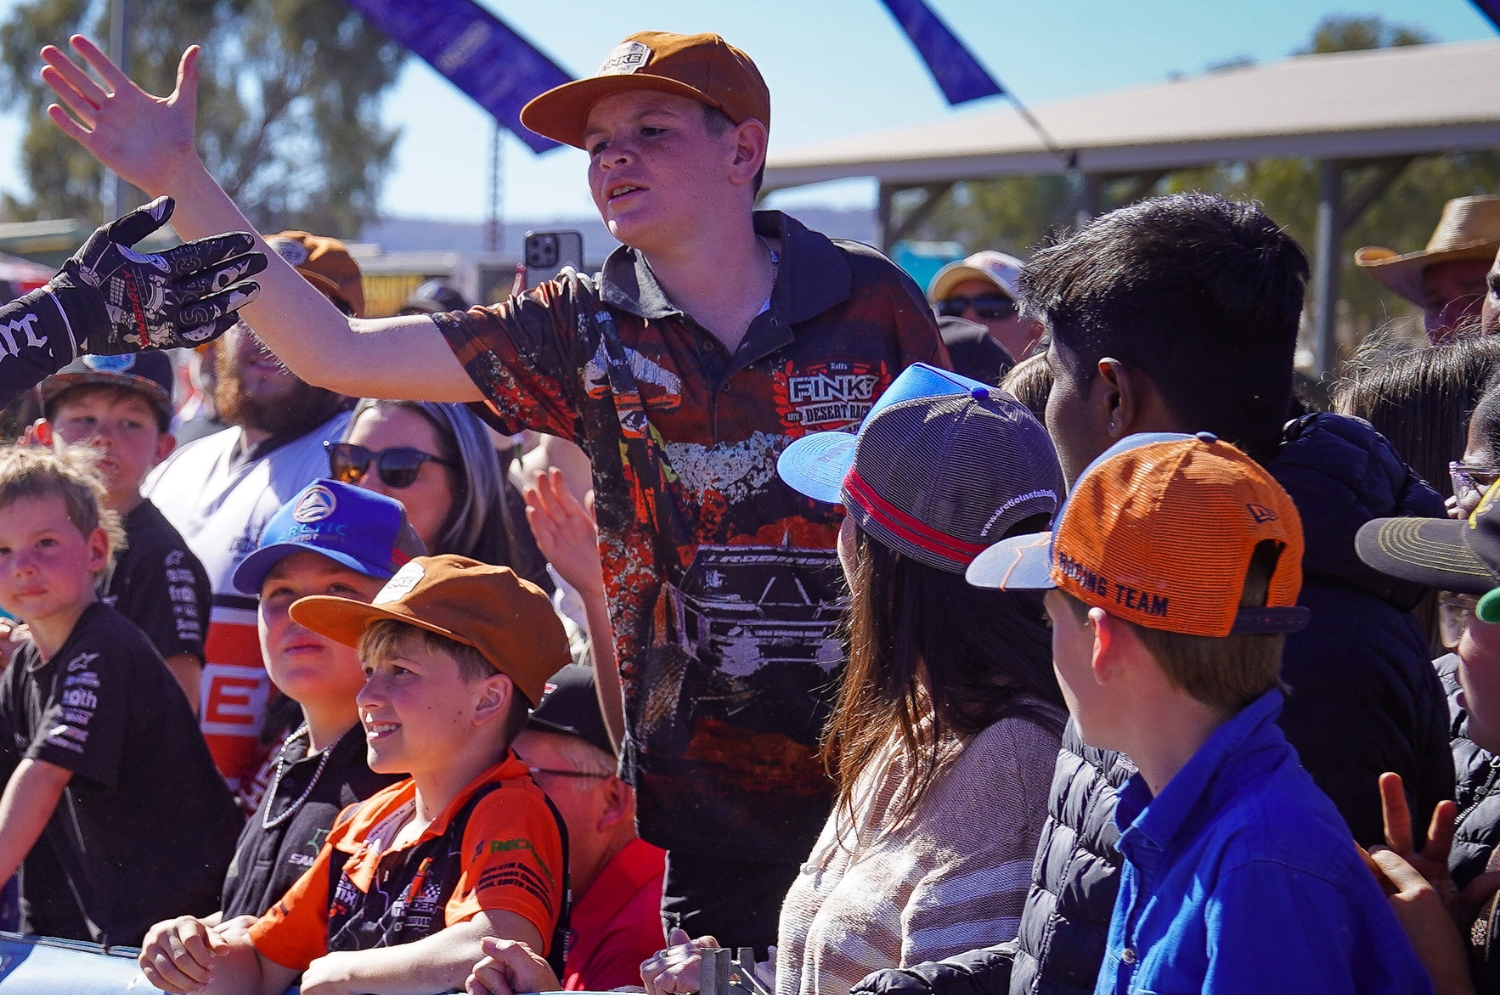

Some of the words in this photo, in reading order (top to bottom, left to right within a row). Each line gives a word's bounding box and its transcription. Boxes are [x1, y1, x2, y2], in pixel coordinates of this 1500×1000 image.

[805, 405, 847, 421] DESERT
[1058, 551, 1107, 598] RACING
[1115, 583, 1169, 618] TEAM
